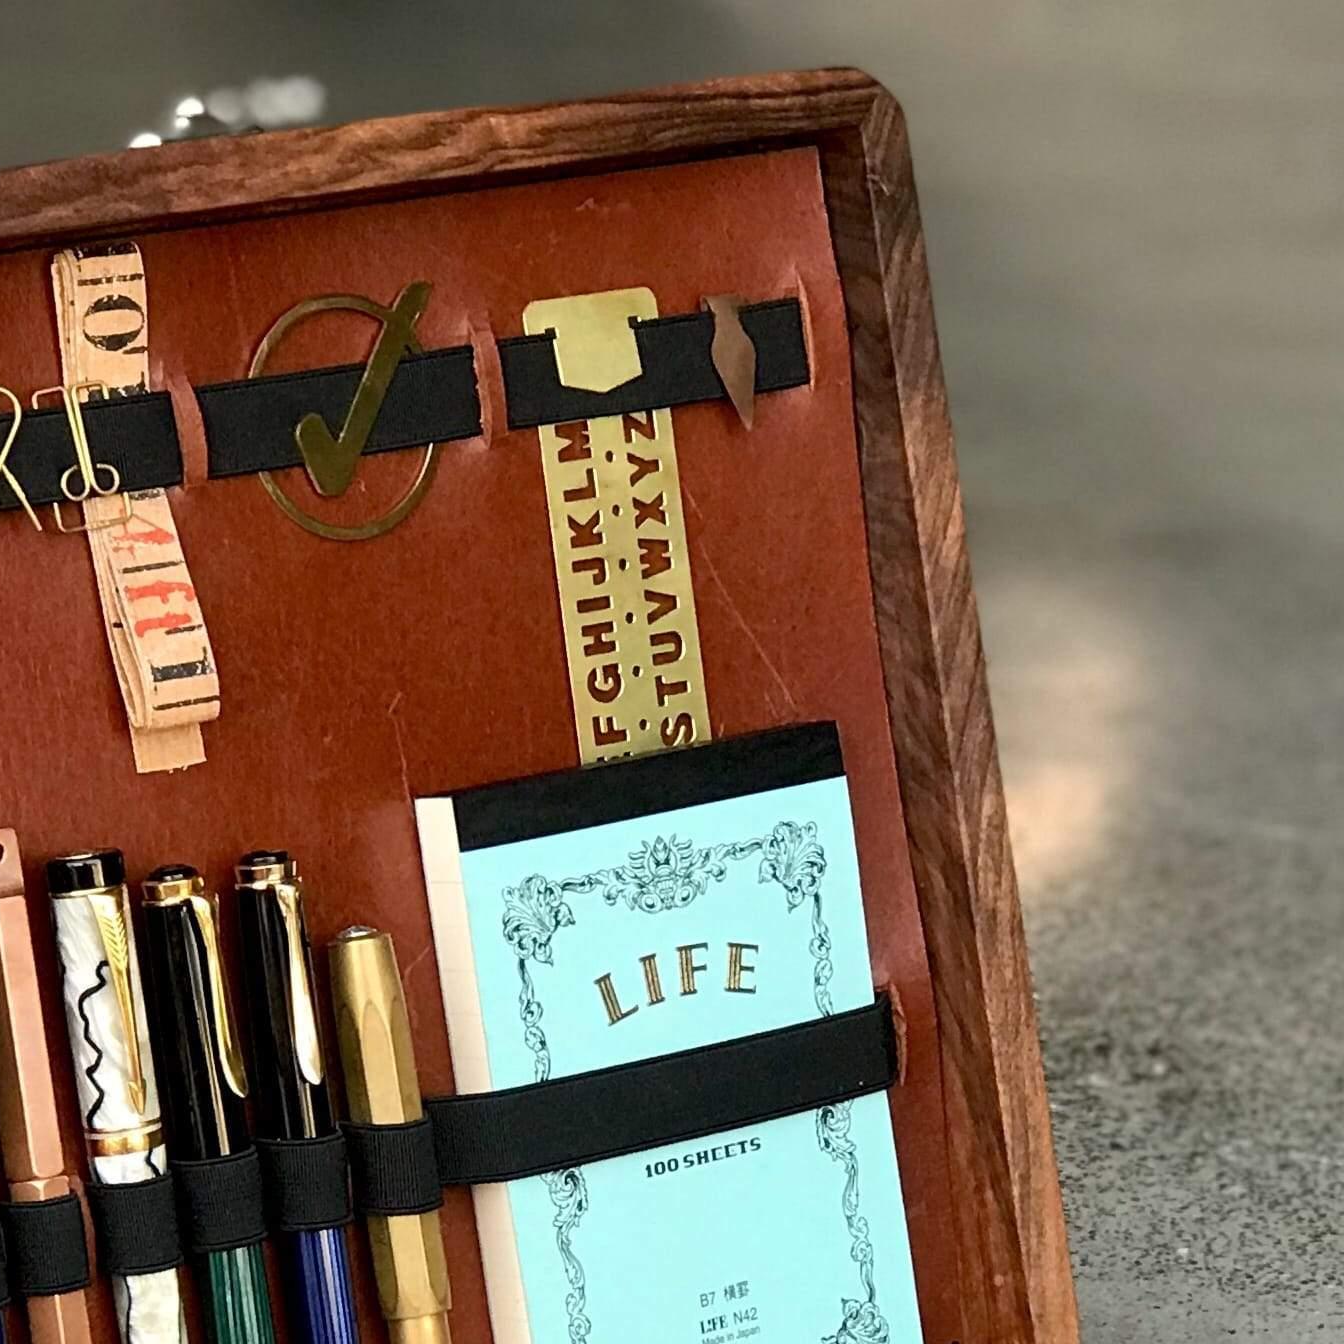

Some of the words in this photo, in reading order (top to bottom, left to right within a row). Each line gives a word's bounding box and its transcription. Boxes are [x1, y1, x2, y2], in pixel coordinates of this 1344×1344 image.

[554, 418, 633, 762] FGHIJKLM
[592, 941, 760, 1027] LIFE
[644, 1156, 680, 1179] 100
[682, 1137, 762, 1169] SHEETS
[699, 1291, 716, 1309] B7
[733, 1306, 759, 1325] N42
[736, 1326, 761, 1340] Japan
